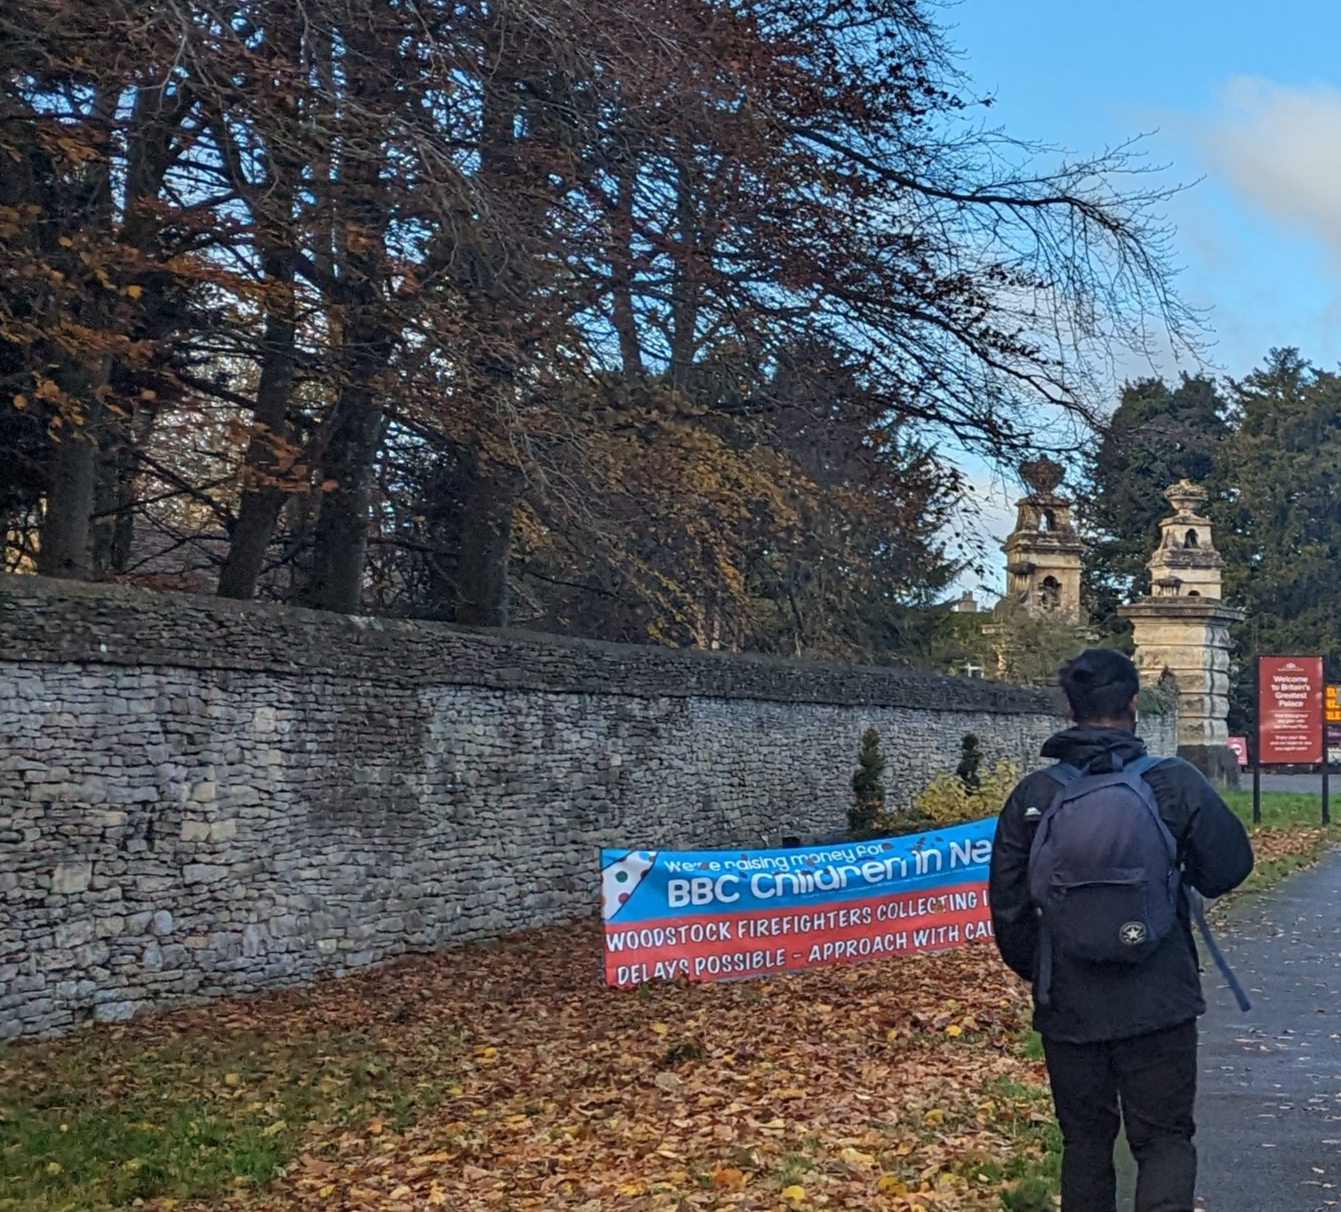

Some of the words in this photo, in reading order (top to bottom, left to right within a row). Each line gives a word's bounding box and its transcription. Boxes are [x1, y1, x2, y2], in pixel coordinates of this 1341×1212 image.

[1272, 675, 1309, 683] Welcome
[1278, 699, 1304, 707] Palace
[668, 874, 740, 908] BBC
[751, 857, 907, 899] Children
[914, 848, 942, 875] in
[724, 856, 789, 871] raising
[791, 849, 857, 867] money
[856, 845, 885, 858] for
[606, 921, 732, 952] WOODSTOCK
[738, 907, 872, 939] FIREFIGHTERS
[877, 893, 977, 921] COLLECTING
[617, 959, 690, 985] DELAYS
[695, 949, 786, 976] POSSIBLE
[808, 931, 907, 963] APPROACH
[913, 925, 959, 947] WITH
